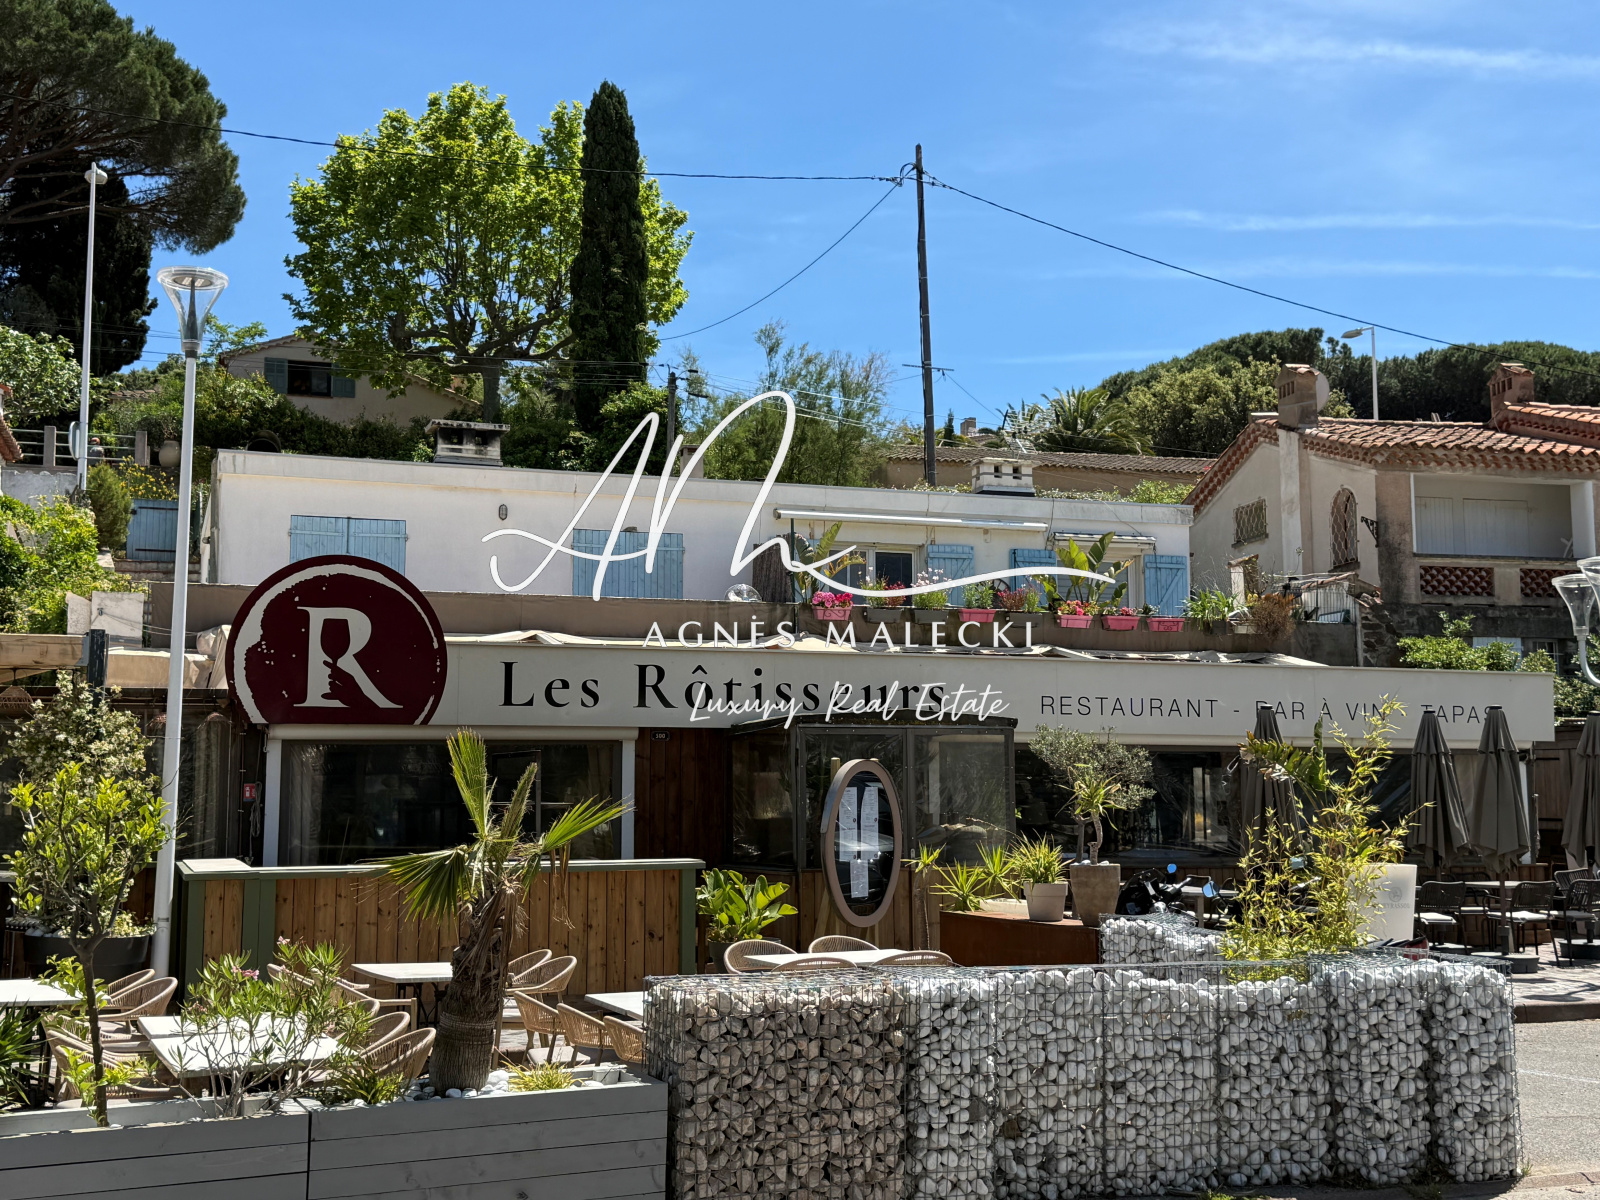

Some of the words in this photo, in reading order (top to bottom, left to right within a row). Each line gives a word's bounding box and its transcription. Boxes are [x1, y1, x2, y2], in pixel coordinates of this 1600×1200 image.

[293, 606, 404, 709] R
[499, 661, 600, 708] Les
[1041, 695, 1218, 718] RESTAURANT
[1319, 697, 1333, 721] À
